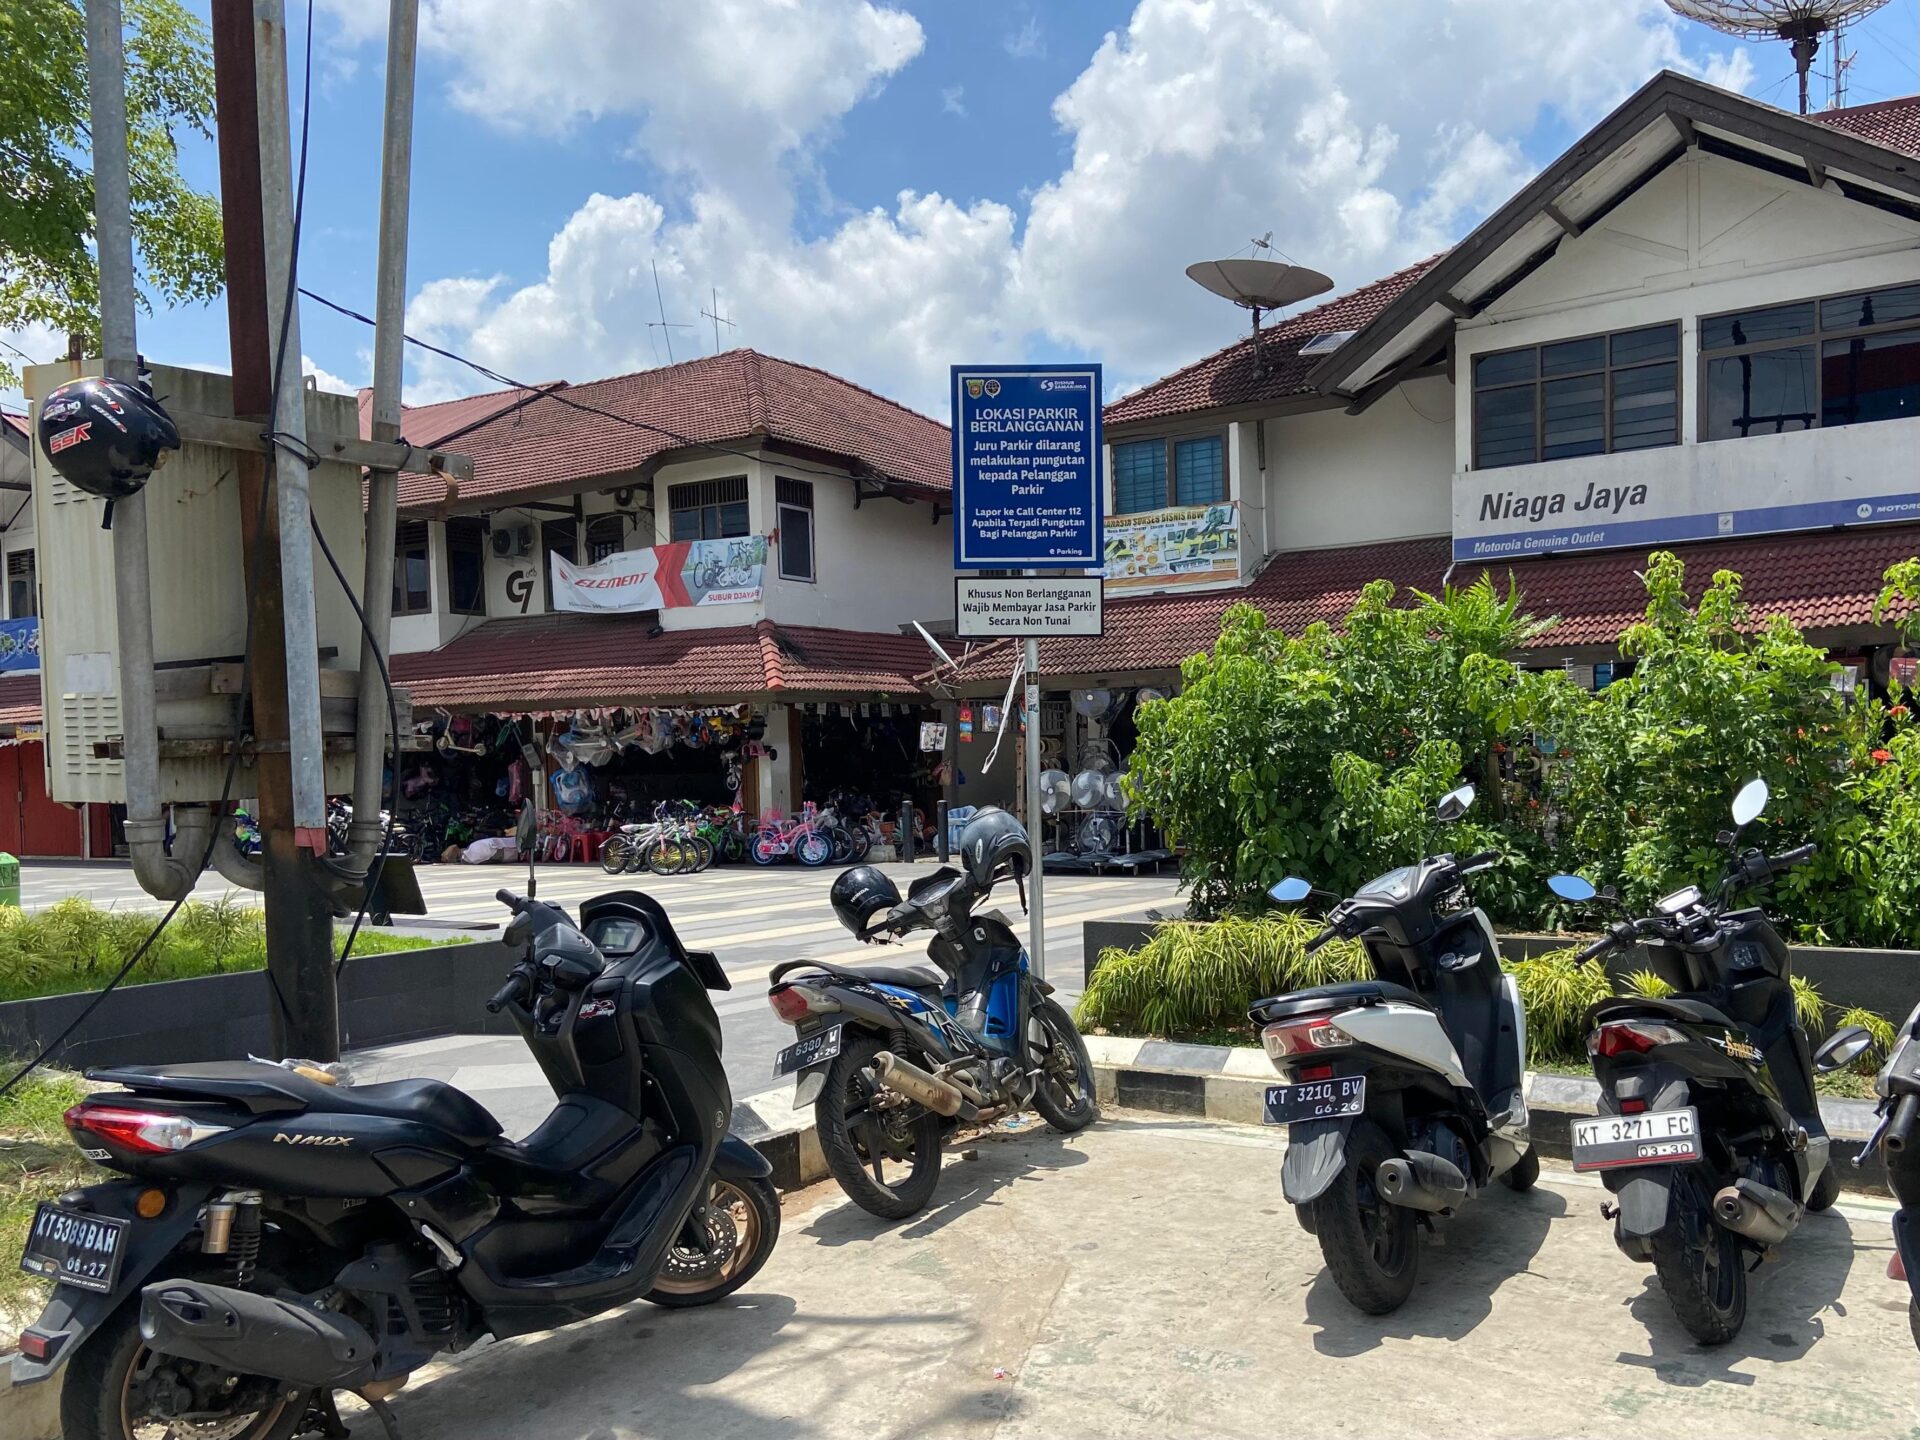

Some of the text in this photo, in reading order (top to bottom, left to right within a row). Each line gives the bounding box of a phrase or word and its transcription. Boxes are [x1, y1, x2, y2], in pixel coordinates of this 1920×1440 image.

[975, 408, 1078, 421] LOKASI PARKIR
[970, 420, 1084, 433] BERLANGGANAN
[974, 440, 1081, 453] Juru Parkir dilarang
[970, 455, 1085, 469] melakukan pungutan
[978, 469, 1077, 483] kepada Pelanggan
[1011, 484, 1044, 495] Parkir
[1479, 482, 1647, 522] Niaga Jaya
[975, 507, 1081, 517] Lapor ke Call Center 112
[972, 518, 1085, 529] Apabila Terjadi Pungutan
[980, 529, 1077, 539] Bagi Pelanggan Parkir
[1474, 532, 1605, 554] Motorola Genuine Outlet
[1056, 548, 1083, 556] Parking
[574, 572, 649, 588] ELEMENT
[708, 591, 732, 602] SUBUR
[967, 588, 1091, 600] Khusus Non Berlangganan
[963, 602, 1096, 614] Wajib Membayar Jasa Parkir
[988, 616, 1071, 626] Secara Non Tunai
[850, 887, 870, 903] HONDA
[777, 1030, 837, 1064] KT 6380 W
[1268, 1080, 1360, 1105] KT 3210 BV
[1578, 1116, 1690, 1145] KT 3271 FC
[273, 1132, 355, 1147] NMAX
